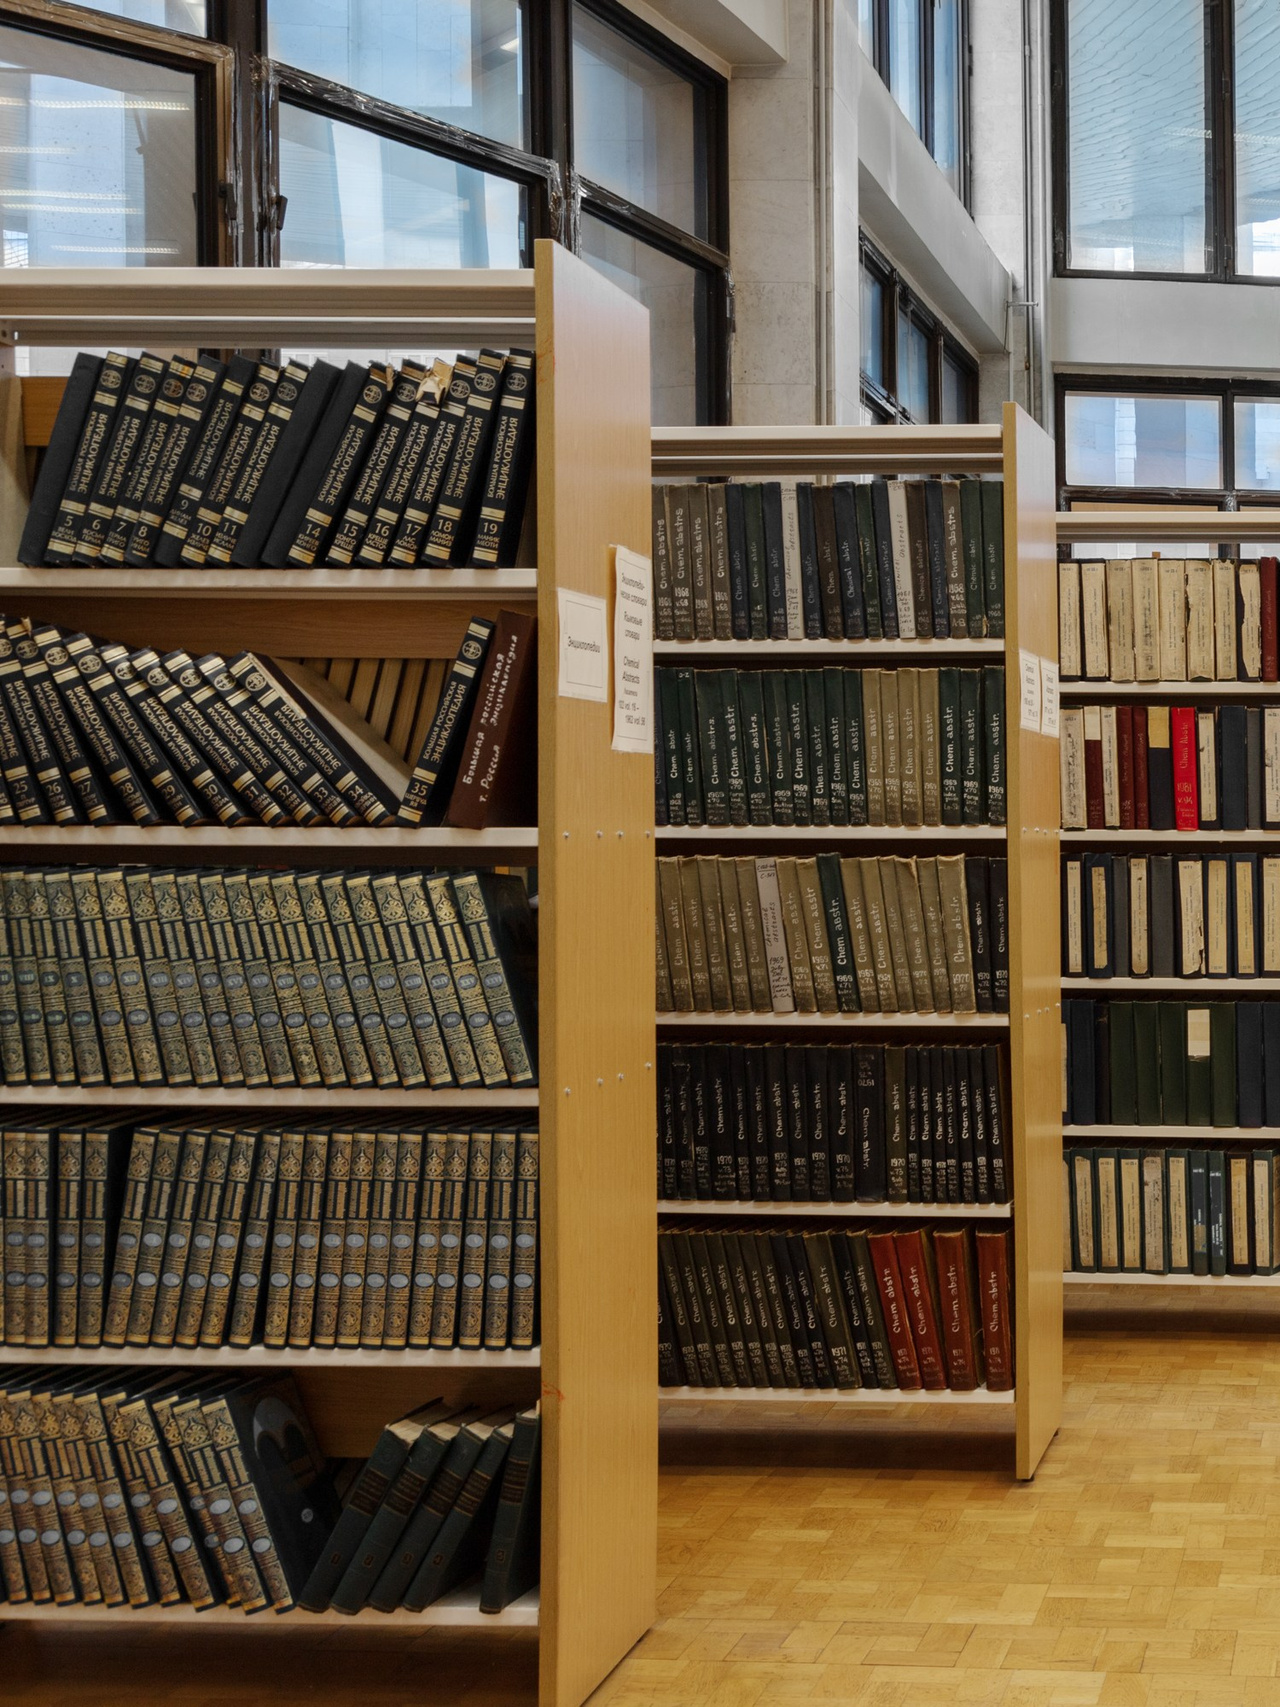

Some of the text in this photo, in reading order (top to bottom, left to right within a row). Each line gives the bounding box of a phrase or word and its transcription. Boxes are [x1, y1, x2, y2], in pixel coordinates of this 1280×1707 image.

[78, 413, 108, 494] ЭНЦИКЛОПЕДИЯ
[495, 417, 519, 499] ЭНЦИКЛОПЕДИЯ
[242, 424, 280, 504] ЭНЦИКЛОПЕДИЯ
[325, 427, 365, 506] ЭНЦИКЛОПЕДИЯ
[362, 426, 400, 505] ЭНЦИКЛОПЕДИЯ
[422, 423, 456, 503] ЭНЦИКЛОПЕДИЯ
[69, 458, 83, 491] БОЛЬШАЯ
[488, 464, 499, 498] БОЛЬШАЯ
[234, 467, 252, 500] БОЛЬШАЯ
[318, 469, 336, 502] БОЛЬШАЯ
[354, 468, 371, 501] БОЛЬШАЯ
[414, 467, 430, 500] БОЛЬШАЯ
[181, 499, 189, 510] 9
[64, 515, 74, 527] 5
[92, 519, 101, 530] 6
[117, 521, 127, 532] 7
[438, 519, 453, 532] 18
[483, 522, 498, 534] 19
[138, 526, 148, 537] 8
[197, 523, 212, 537] 10
[223, 522, 237, 536] 11
[305, 523, 321, 538] 14
[343, 523, 358, 537] 15
[375, 523, 390, 537] 16
[406, 523, 422, 536] 17
[623, 656, 640, 669] Chemical
[423, 681, 457, 760] БОЛЬШАЯ РОССИЙСКАЯ
[431, 683, 467, 763] ЭНЦИКЛОПЕДИЯ
[147, 696, 200, 767] ЭНЦИКЛОПЕДИЯ
[168, 741, 191, 771] БОЛЬШАЯ
[462, 732, 485, 785] Большая
[480, 745, 500, 789] Россия
[14, 781, 28, 794] 25
[46, 782, 62, 796] 26
[80, 781, 91, 795] 27
[162, 785, 175, 799] 29
[204, 784, 218, 799] 30
[245, 786, 259, 800] 31
[276, 785, 290, 800] 32
[314, 787, 329, 801] 33
[348, 785, 364, 801] 34
[411, 782, 428, 796] 35
[989, 786, 1004, 794] 1969
[837, 933, 847, 965] Chem.
[98, 975, 109, 983] XI
[123, 974, 137, 982] XII
[152, 975, 168, 983] XIII
[330, 977, 342, 985] XX
